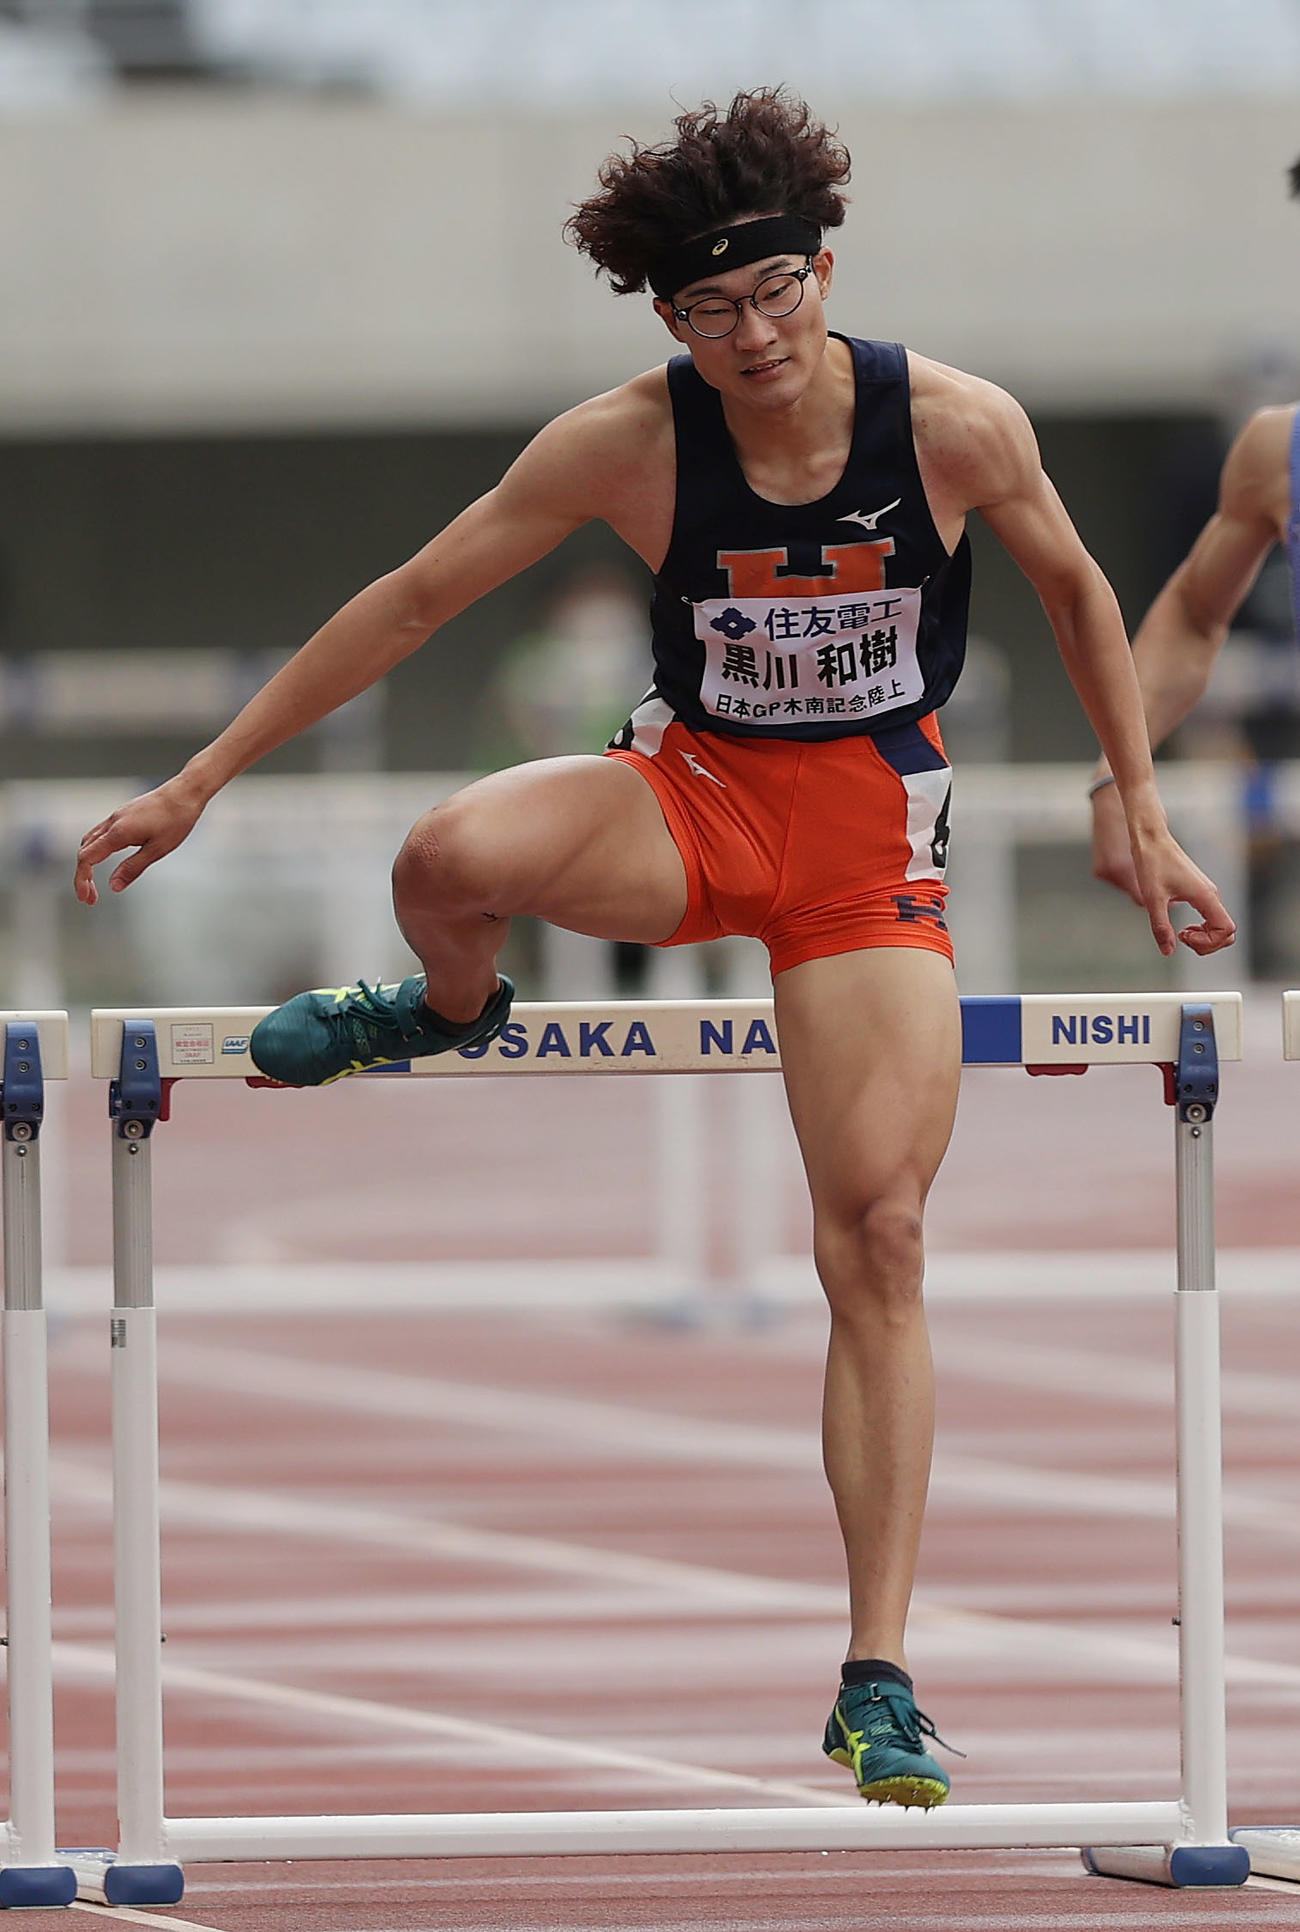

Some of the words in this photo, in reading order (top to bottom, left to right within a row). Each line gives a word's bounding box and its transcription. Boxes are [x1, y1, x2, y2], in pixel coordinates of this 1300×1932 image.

[764, 598, 902, 641] 住友電工
[721, 643, 799, 690] 黒川
[817, 625, 898, 688] 和樹
[716, 680, 905, 719] 日本GP木南記念陸上
[1052, 1015, 1149, 1044] NISHI
